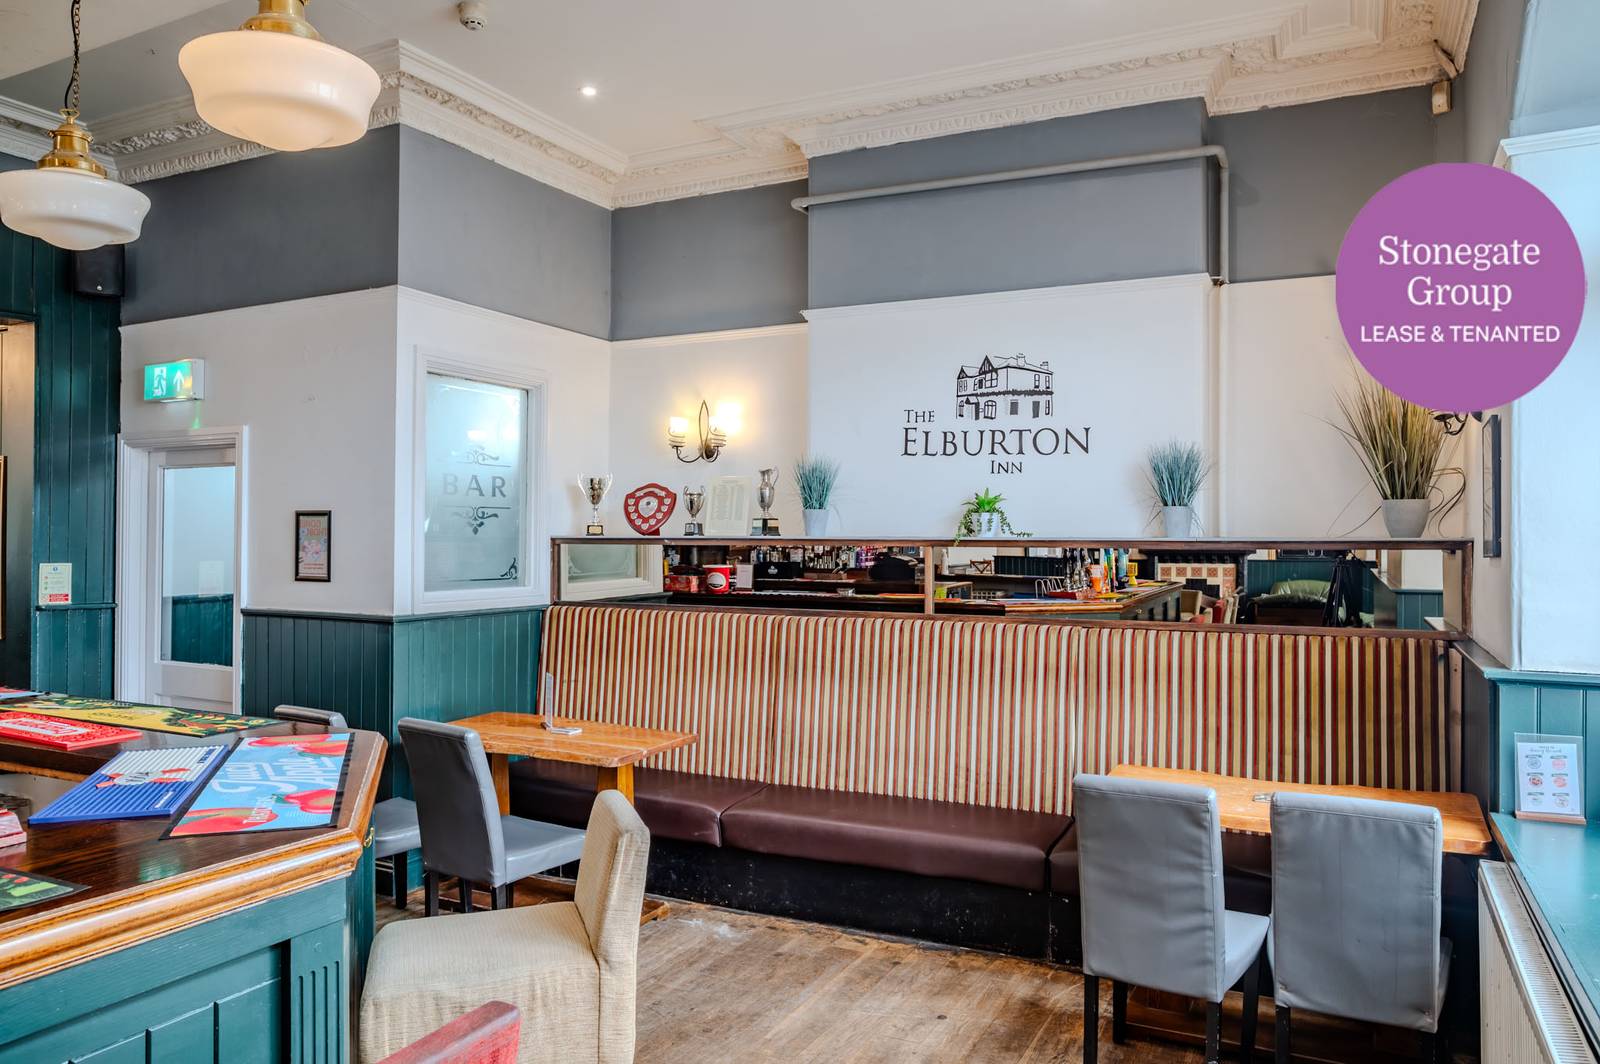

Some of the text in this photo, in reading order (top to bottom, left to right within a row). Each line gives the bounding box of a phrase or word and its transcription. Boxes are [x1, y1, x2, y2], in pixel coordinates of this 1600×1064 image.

[904, 409, 935, 424] THE
[901, 427, 1091, 457] ELBURTON
[990, 460, 1023, 474] INN
[442, 473, 507, 498] BAR
